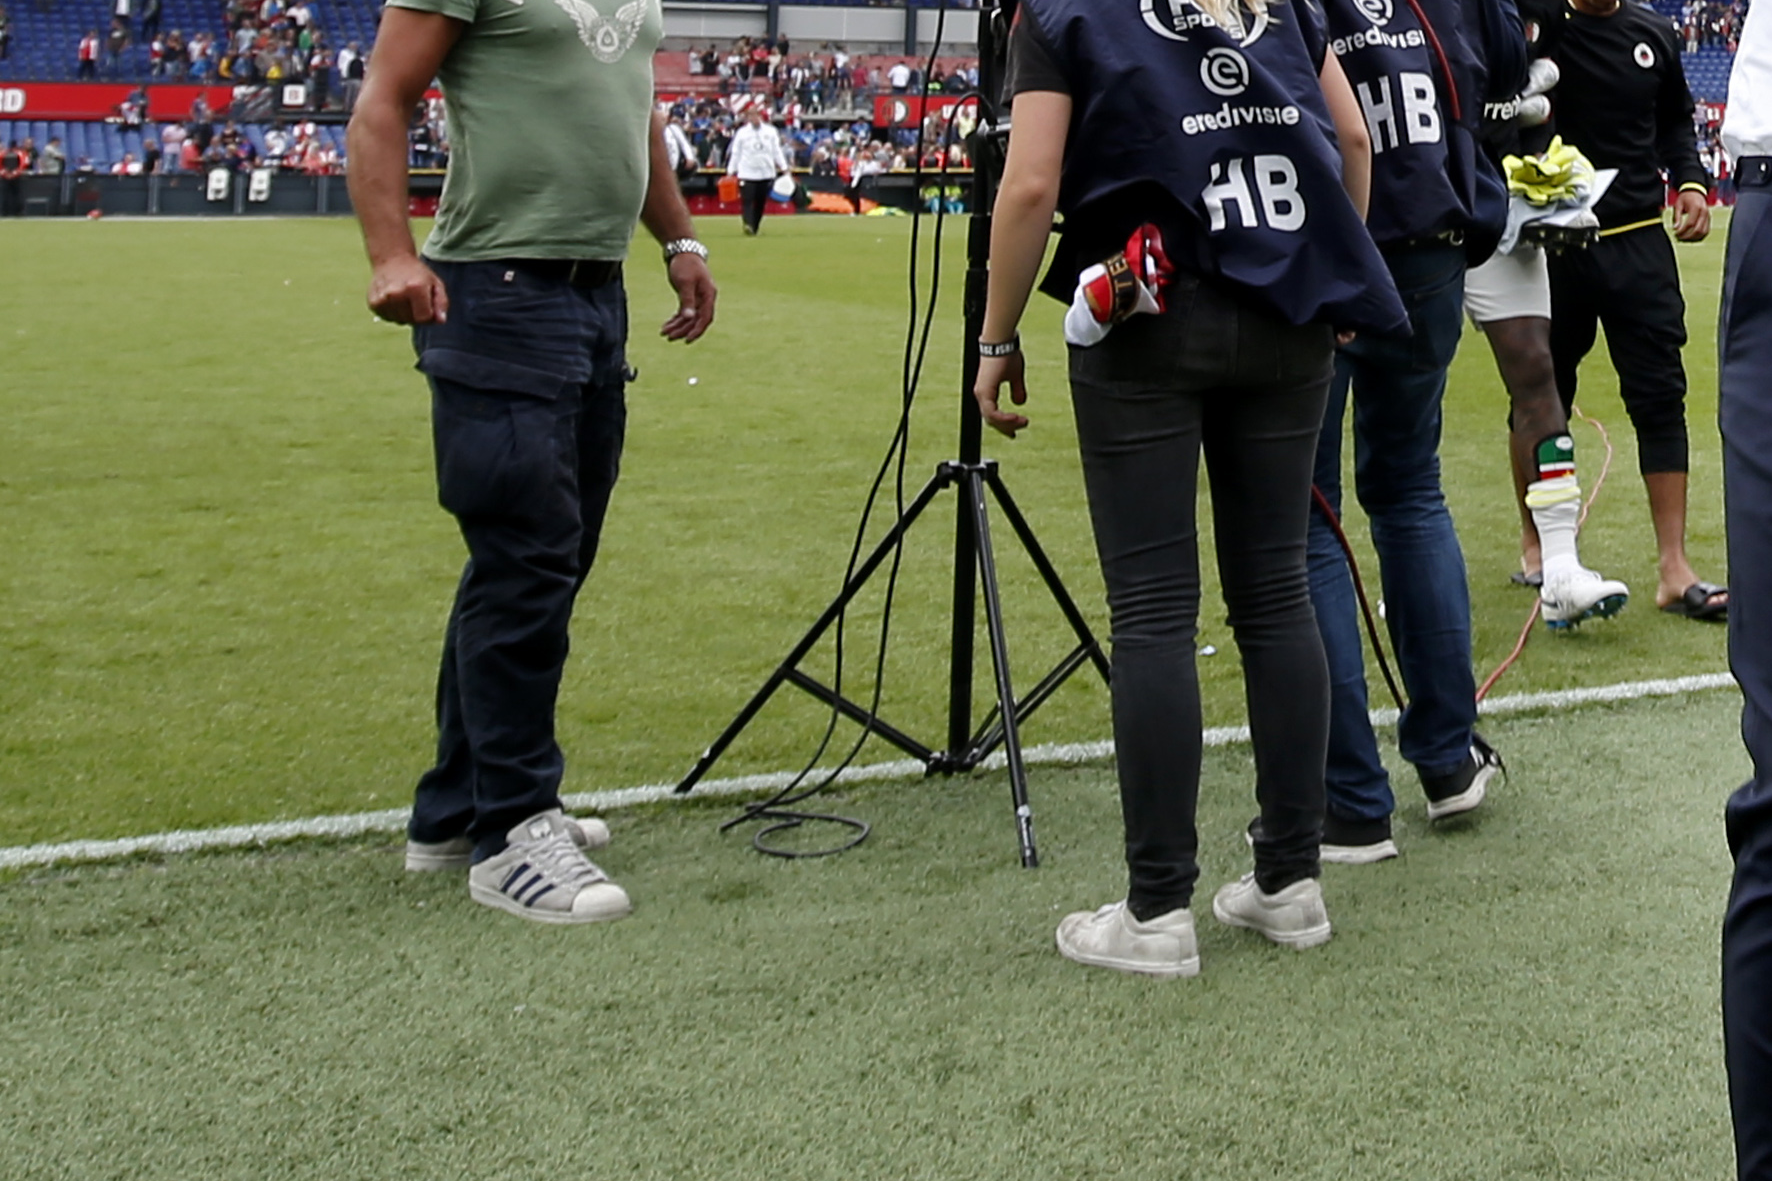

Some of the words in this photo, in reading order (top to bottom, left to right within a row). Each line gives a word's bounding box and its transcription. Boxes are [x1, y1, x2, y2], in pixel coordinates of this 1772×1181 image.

[1181, 102, 1300, 135] eredivisie
[1356, 71, 1442, 155] HB
[1201, 155, 1306, 232] HB
